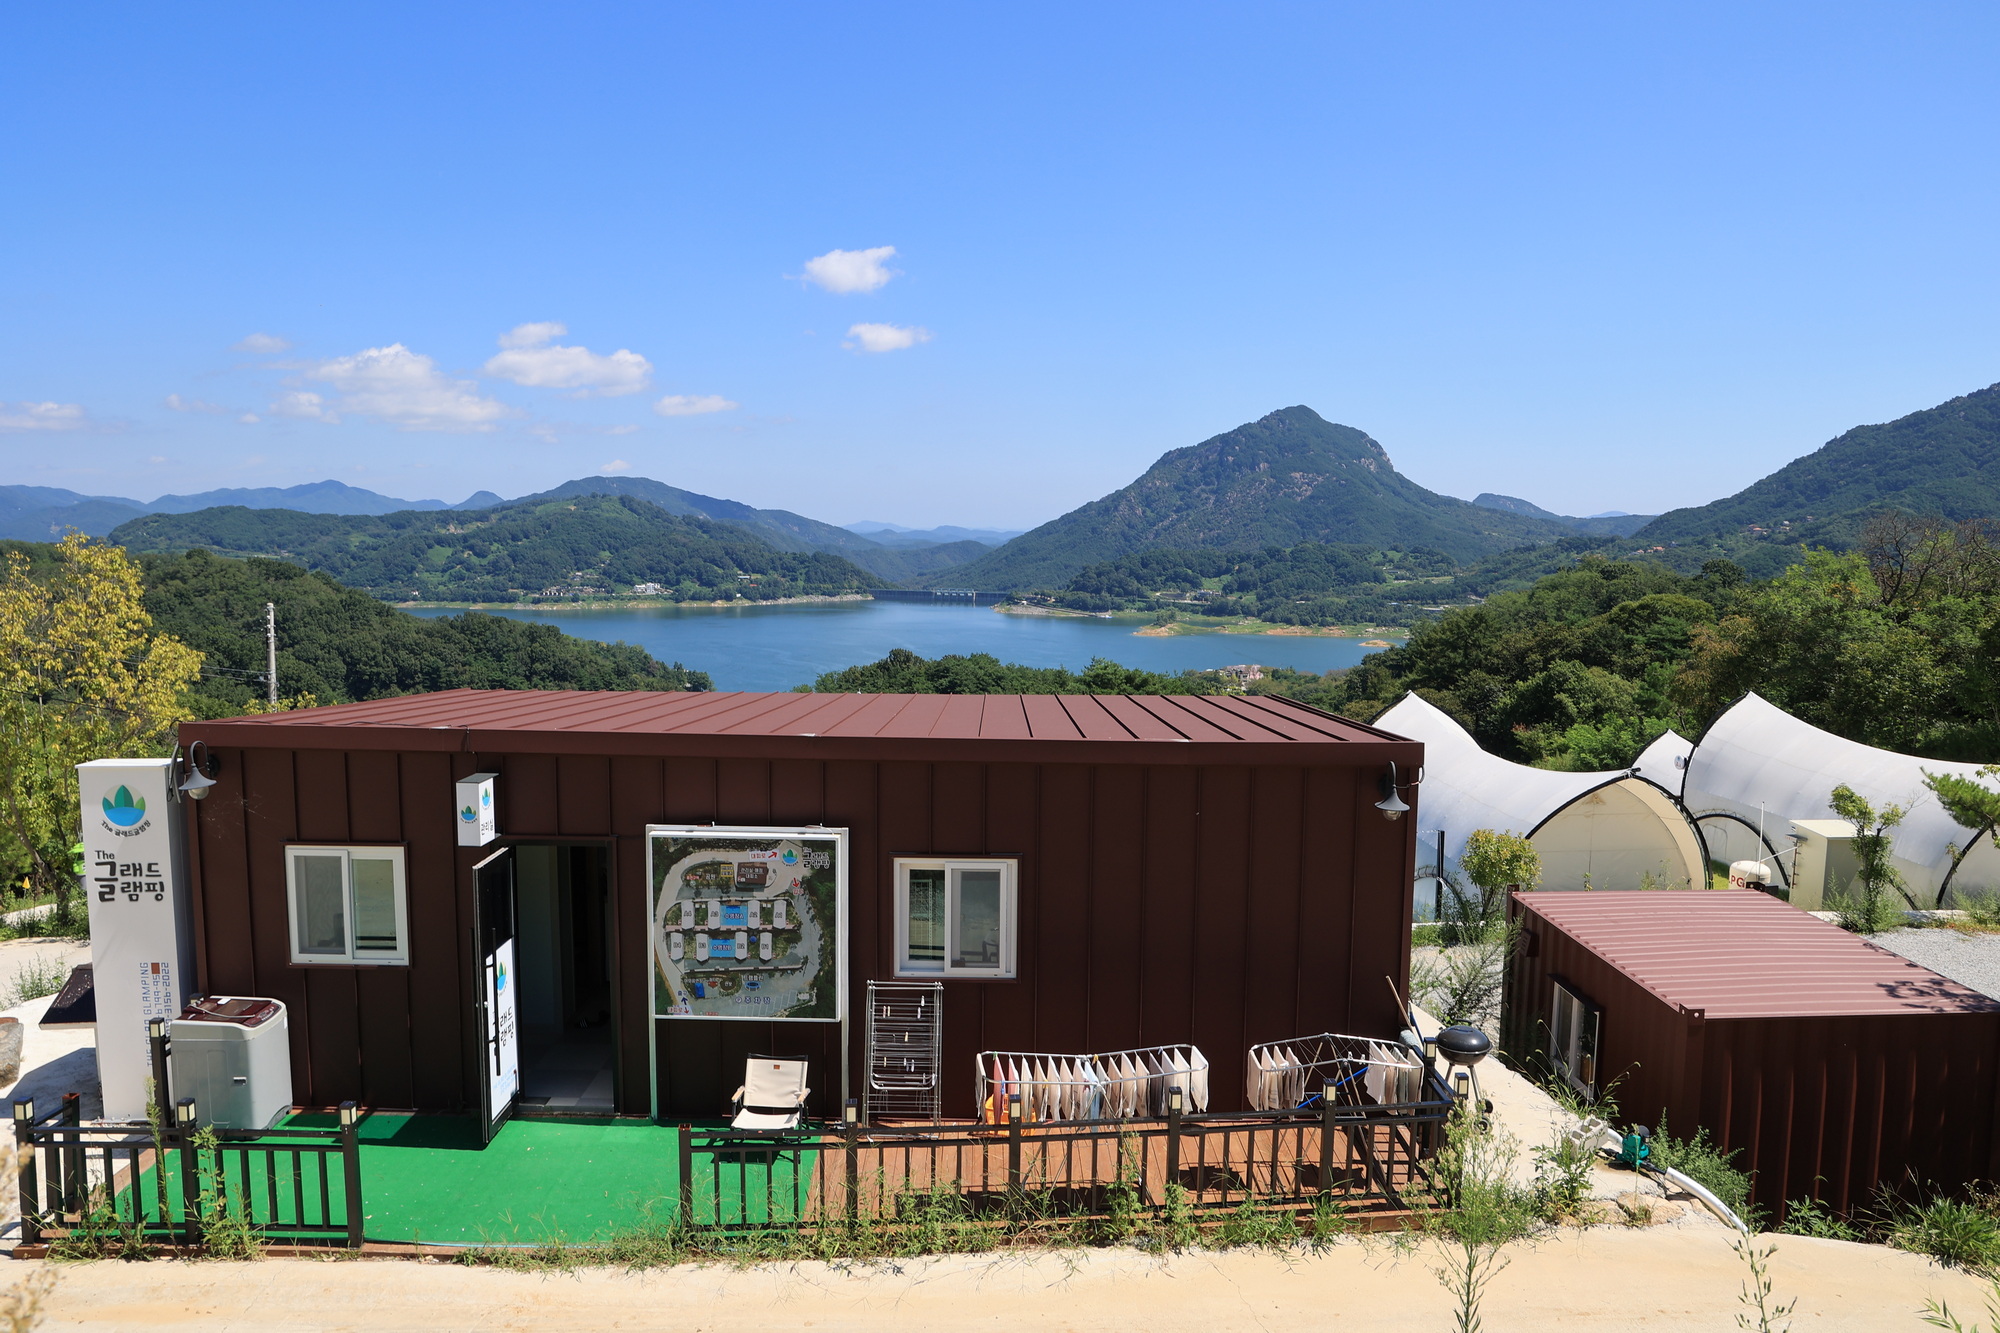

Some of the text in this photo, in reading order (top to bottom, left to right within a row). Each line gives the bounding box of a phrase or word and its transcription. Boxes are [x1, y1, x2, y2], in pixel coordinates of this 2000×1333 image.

[101, 820, 113, 833] The
[95, 850, 115, 860] The
[1730, 875, 1745, 888] PG
[140, 962, 152, 1015] GLAMPING
